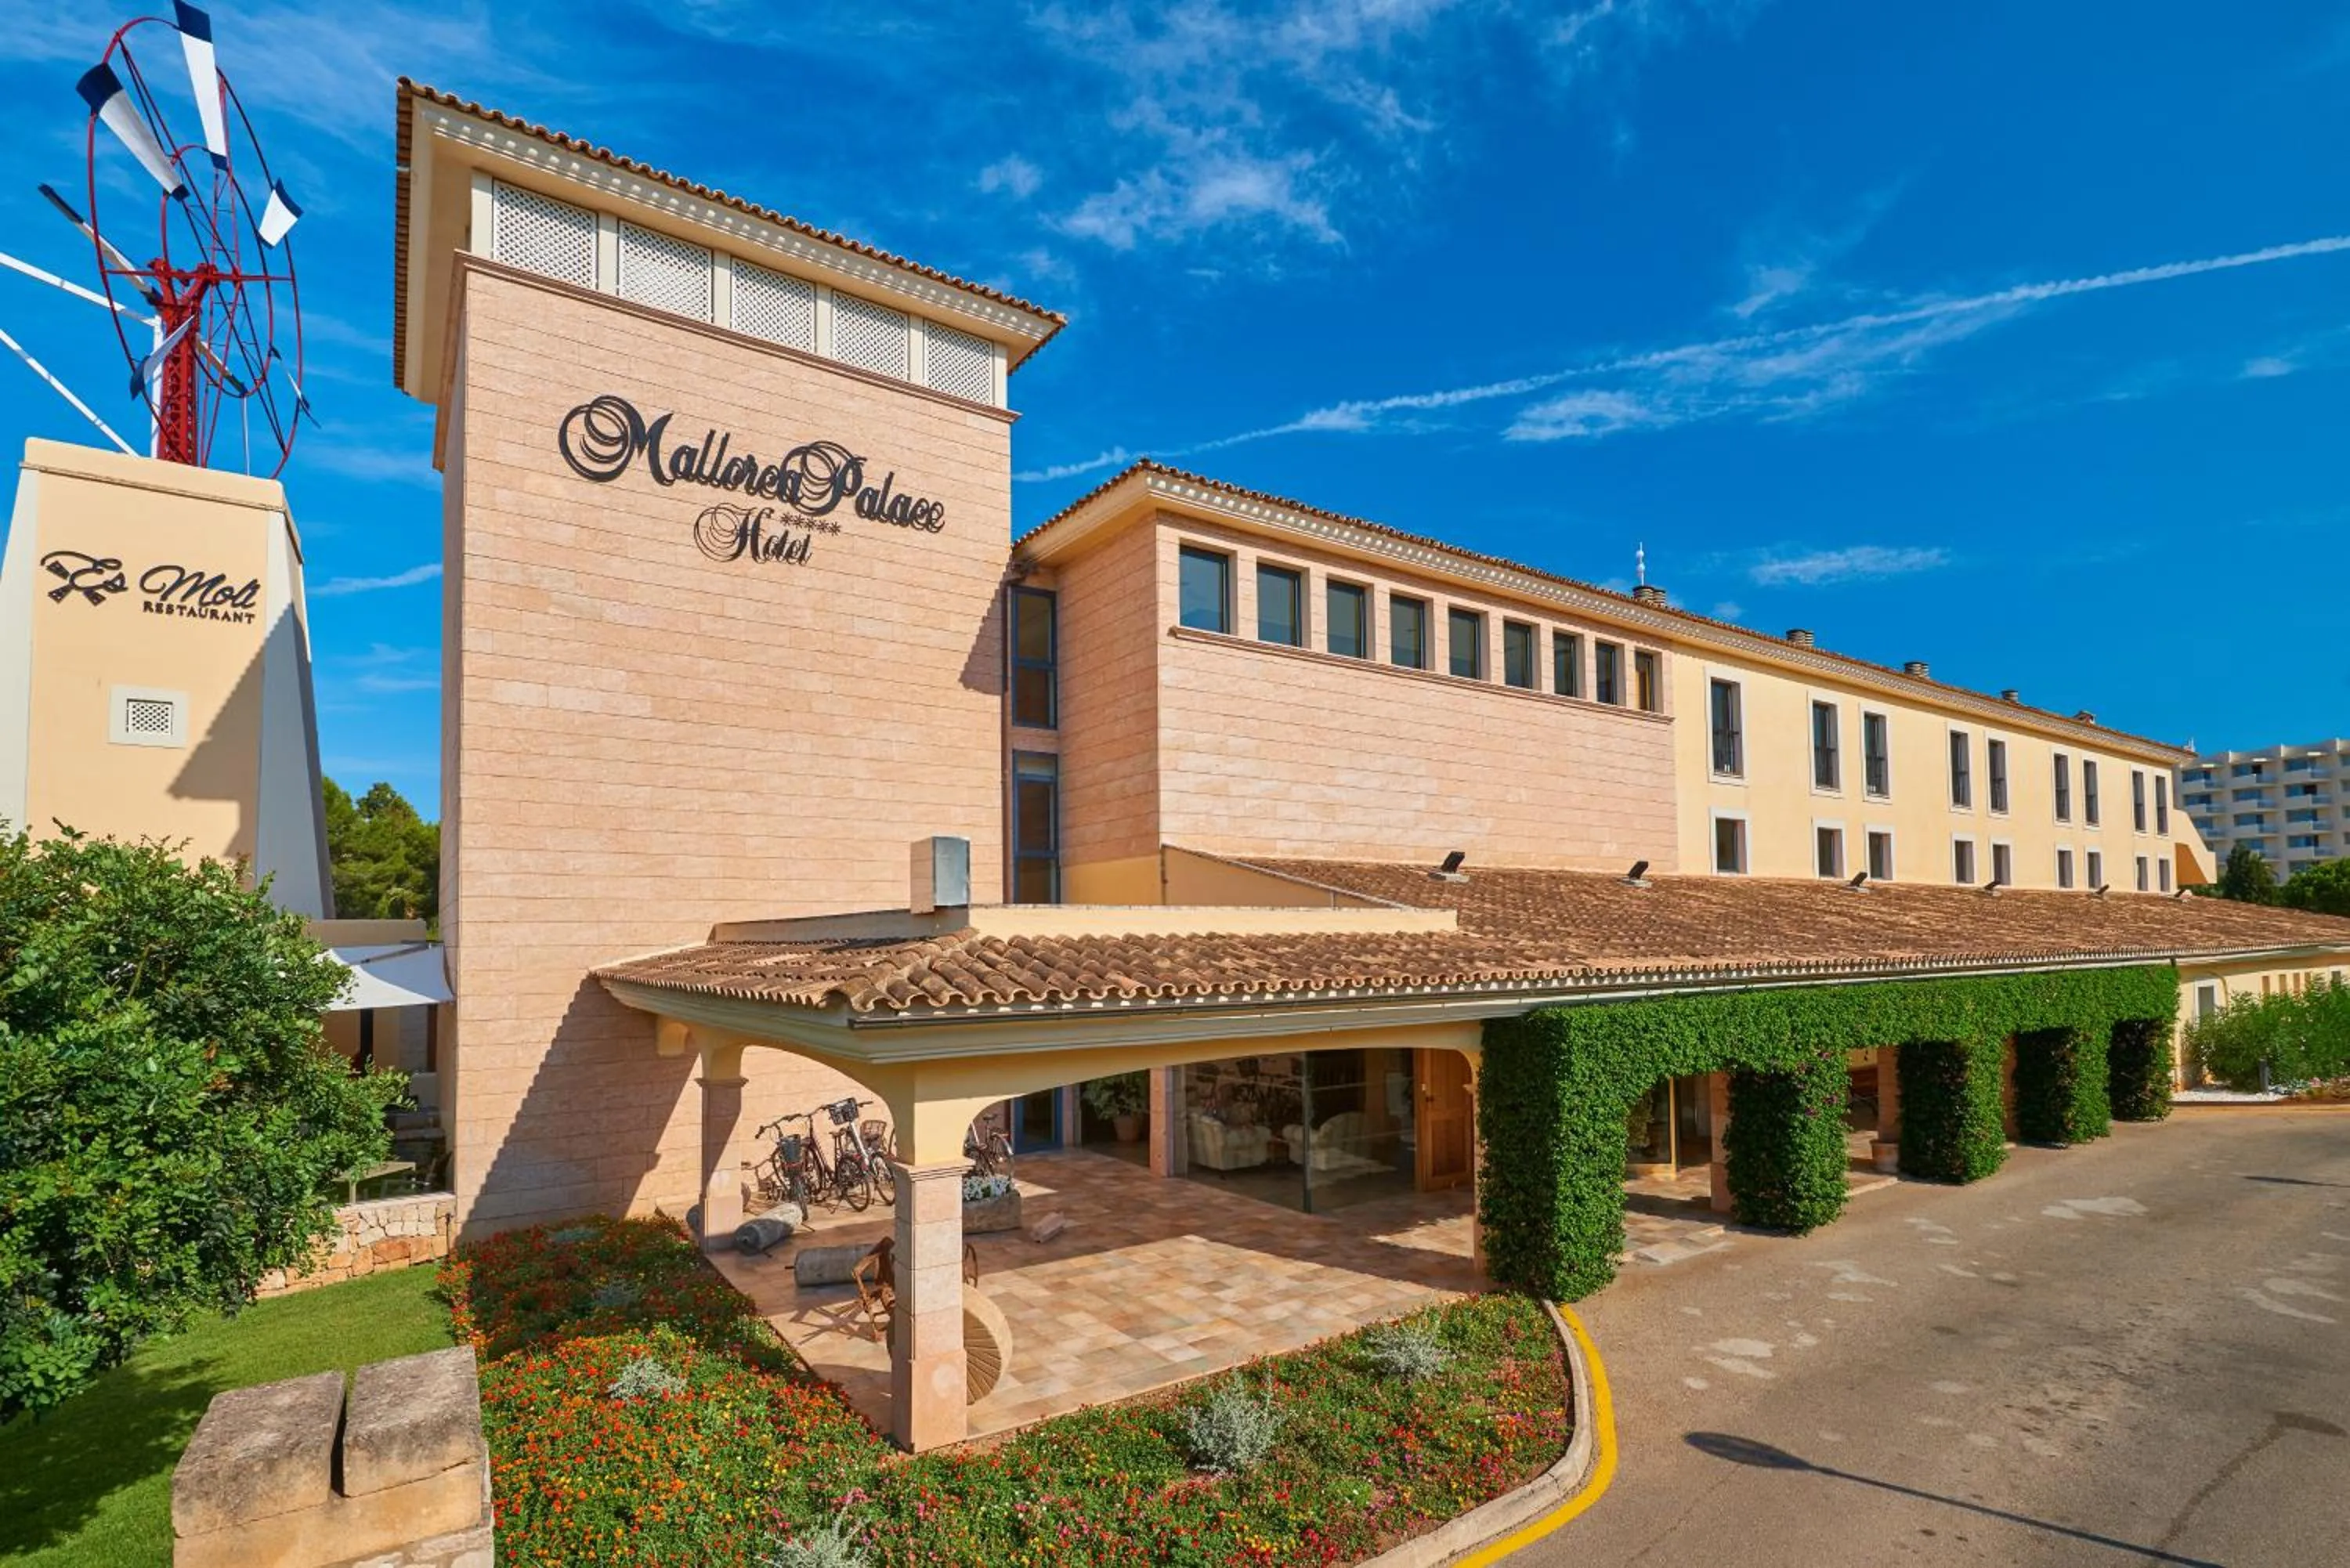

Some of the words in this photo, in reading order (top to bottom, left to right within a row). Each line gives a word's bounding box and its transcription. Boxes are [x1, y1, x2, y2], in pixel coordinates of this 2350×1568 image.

[558, 394, 803, 504] Mallorca
[782, 440, 945, 533] Palace
[693, 502, 813, 566] Hotel
[143, 601, 255, 624] RESTAURANT
